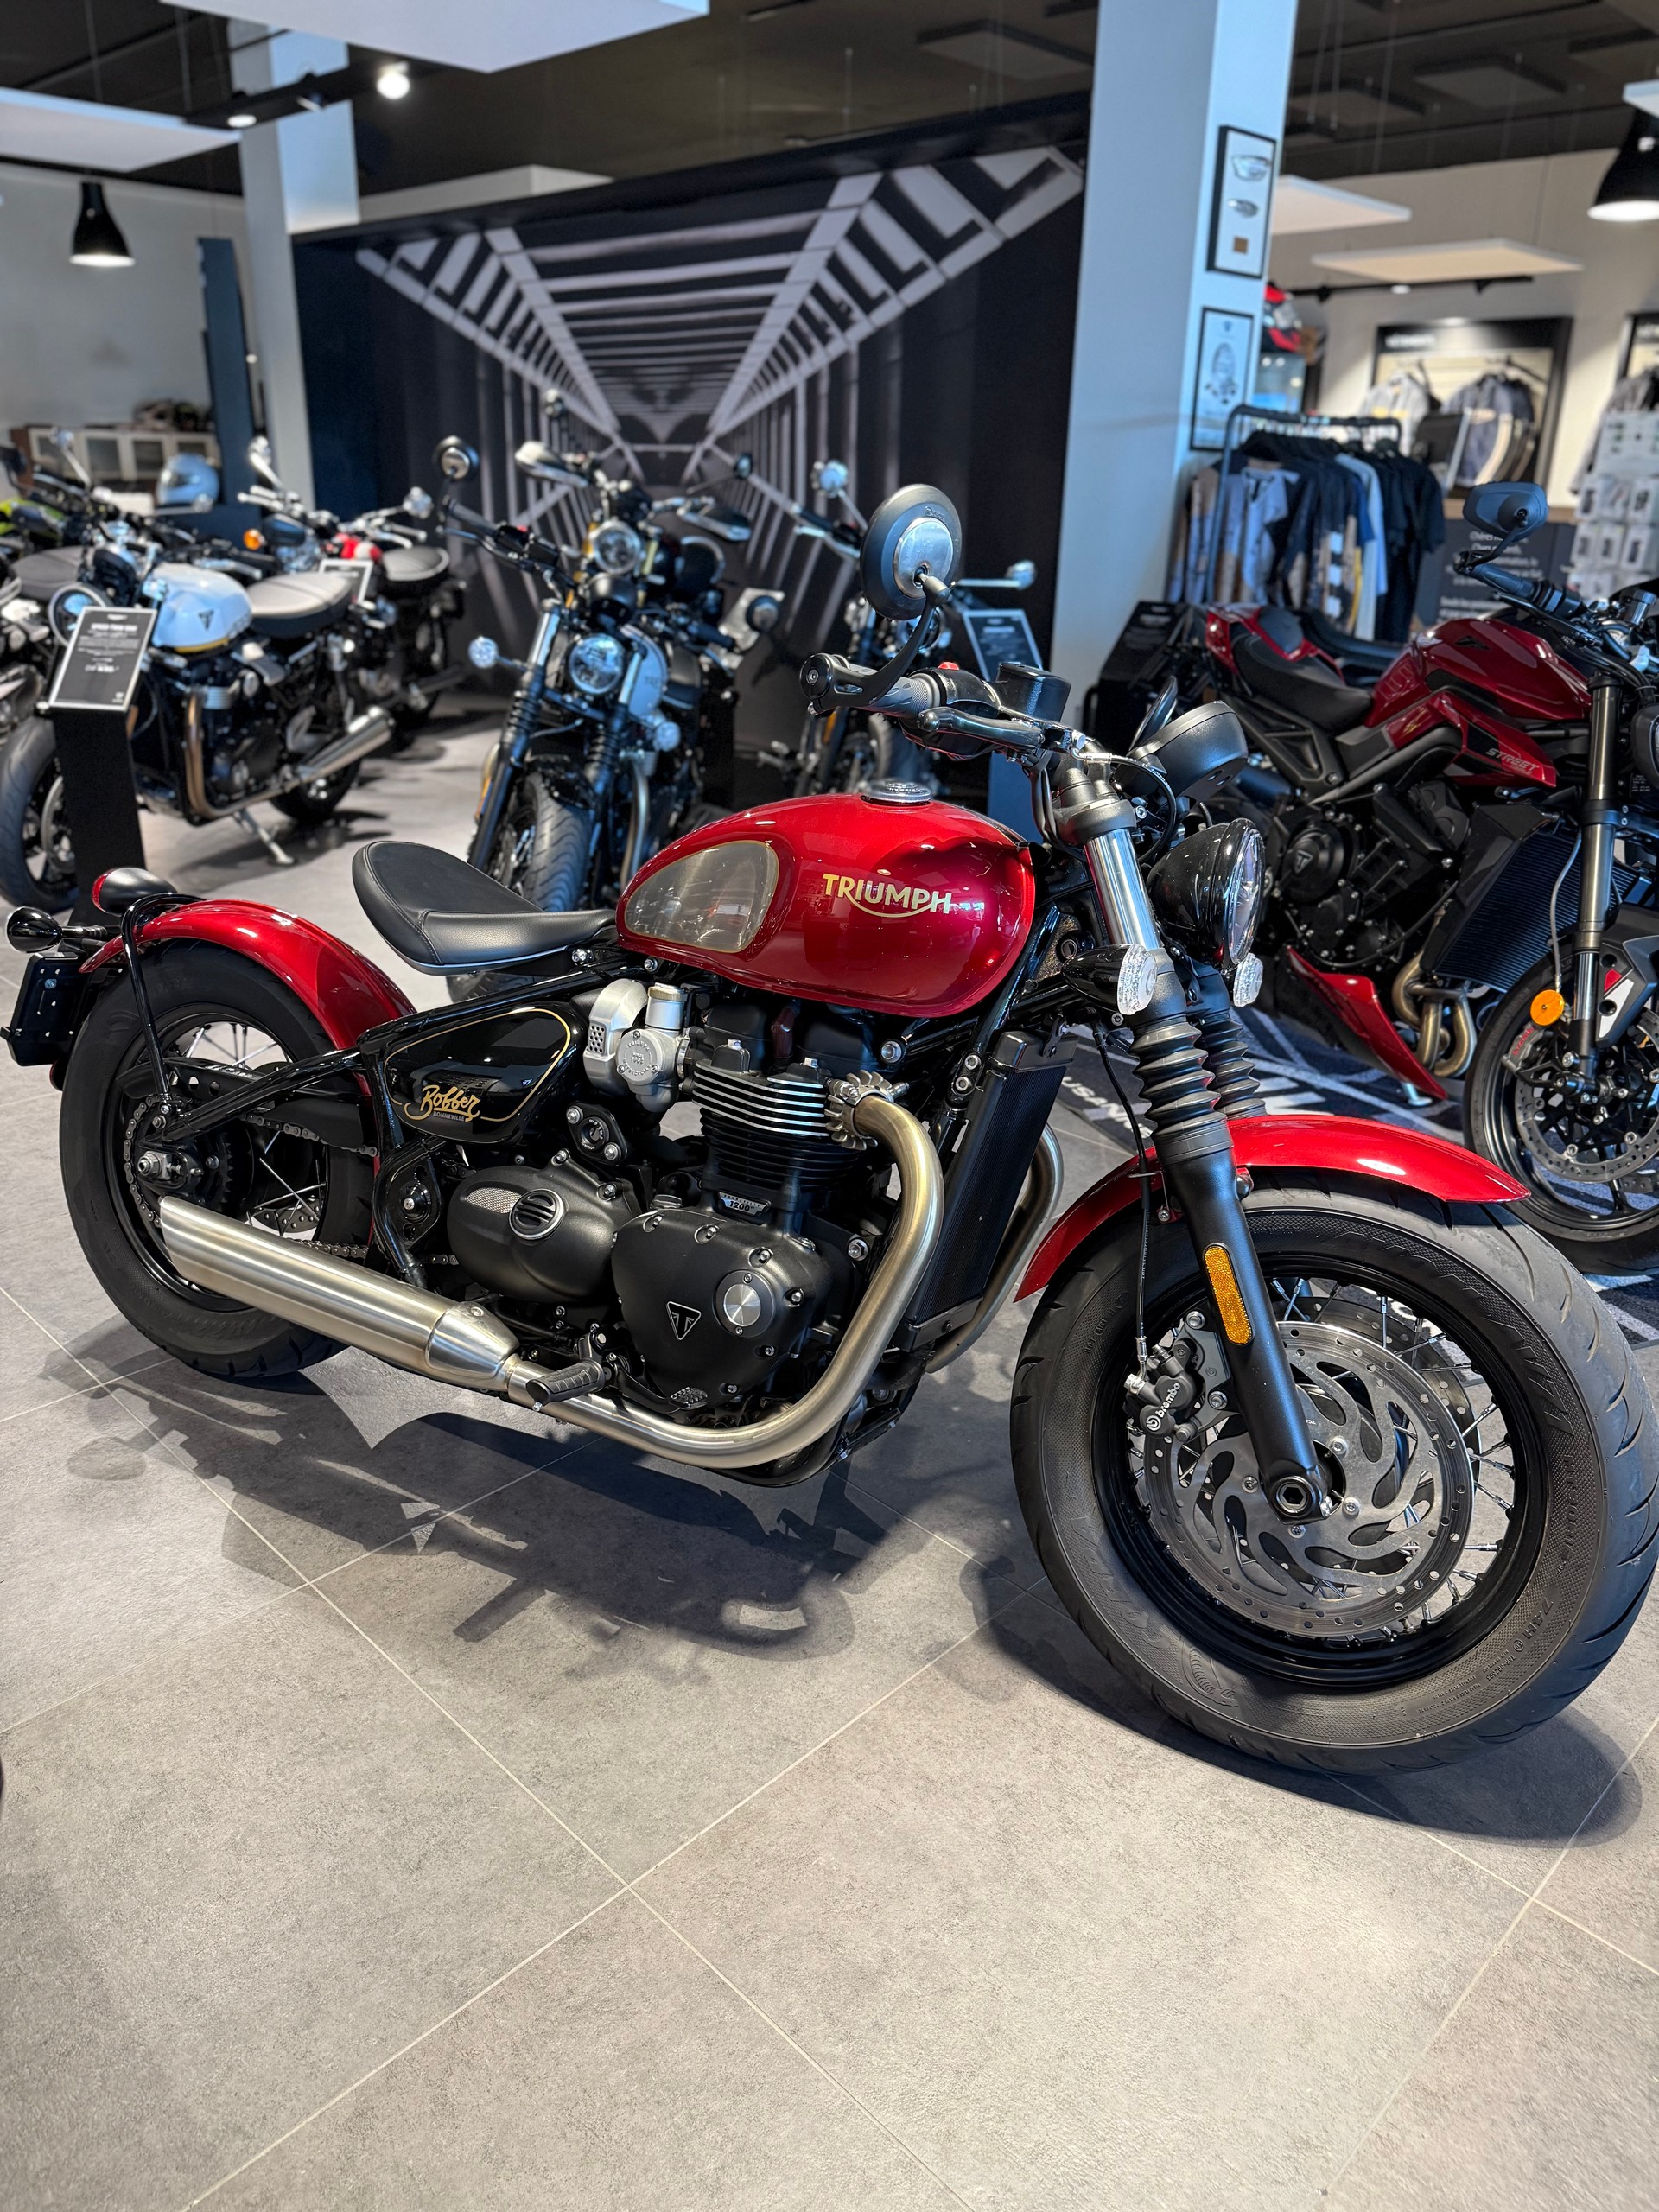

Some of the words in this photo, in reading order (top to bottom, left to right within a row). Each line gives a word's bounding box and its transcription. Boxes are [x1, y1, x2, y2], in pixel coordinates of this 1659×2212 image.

[1486, 747, 1540, 772] STREET
[823, 873, 952, 918] TRIUMPH
[404, 1084, 481, 1122] Bobber
[433, 1111, 465, 1122] BONNEVILLE
[1154, 1382, 1181, 1418] brembo
[1522, 1598, 1554, 1640] 74H
